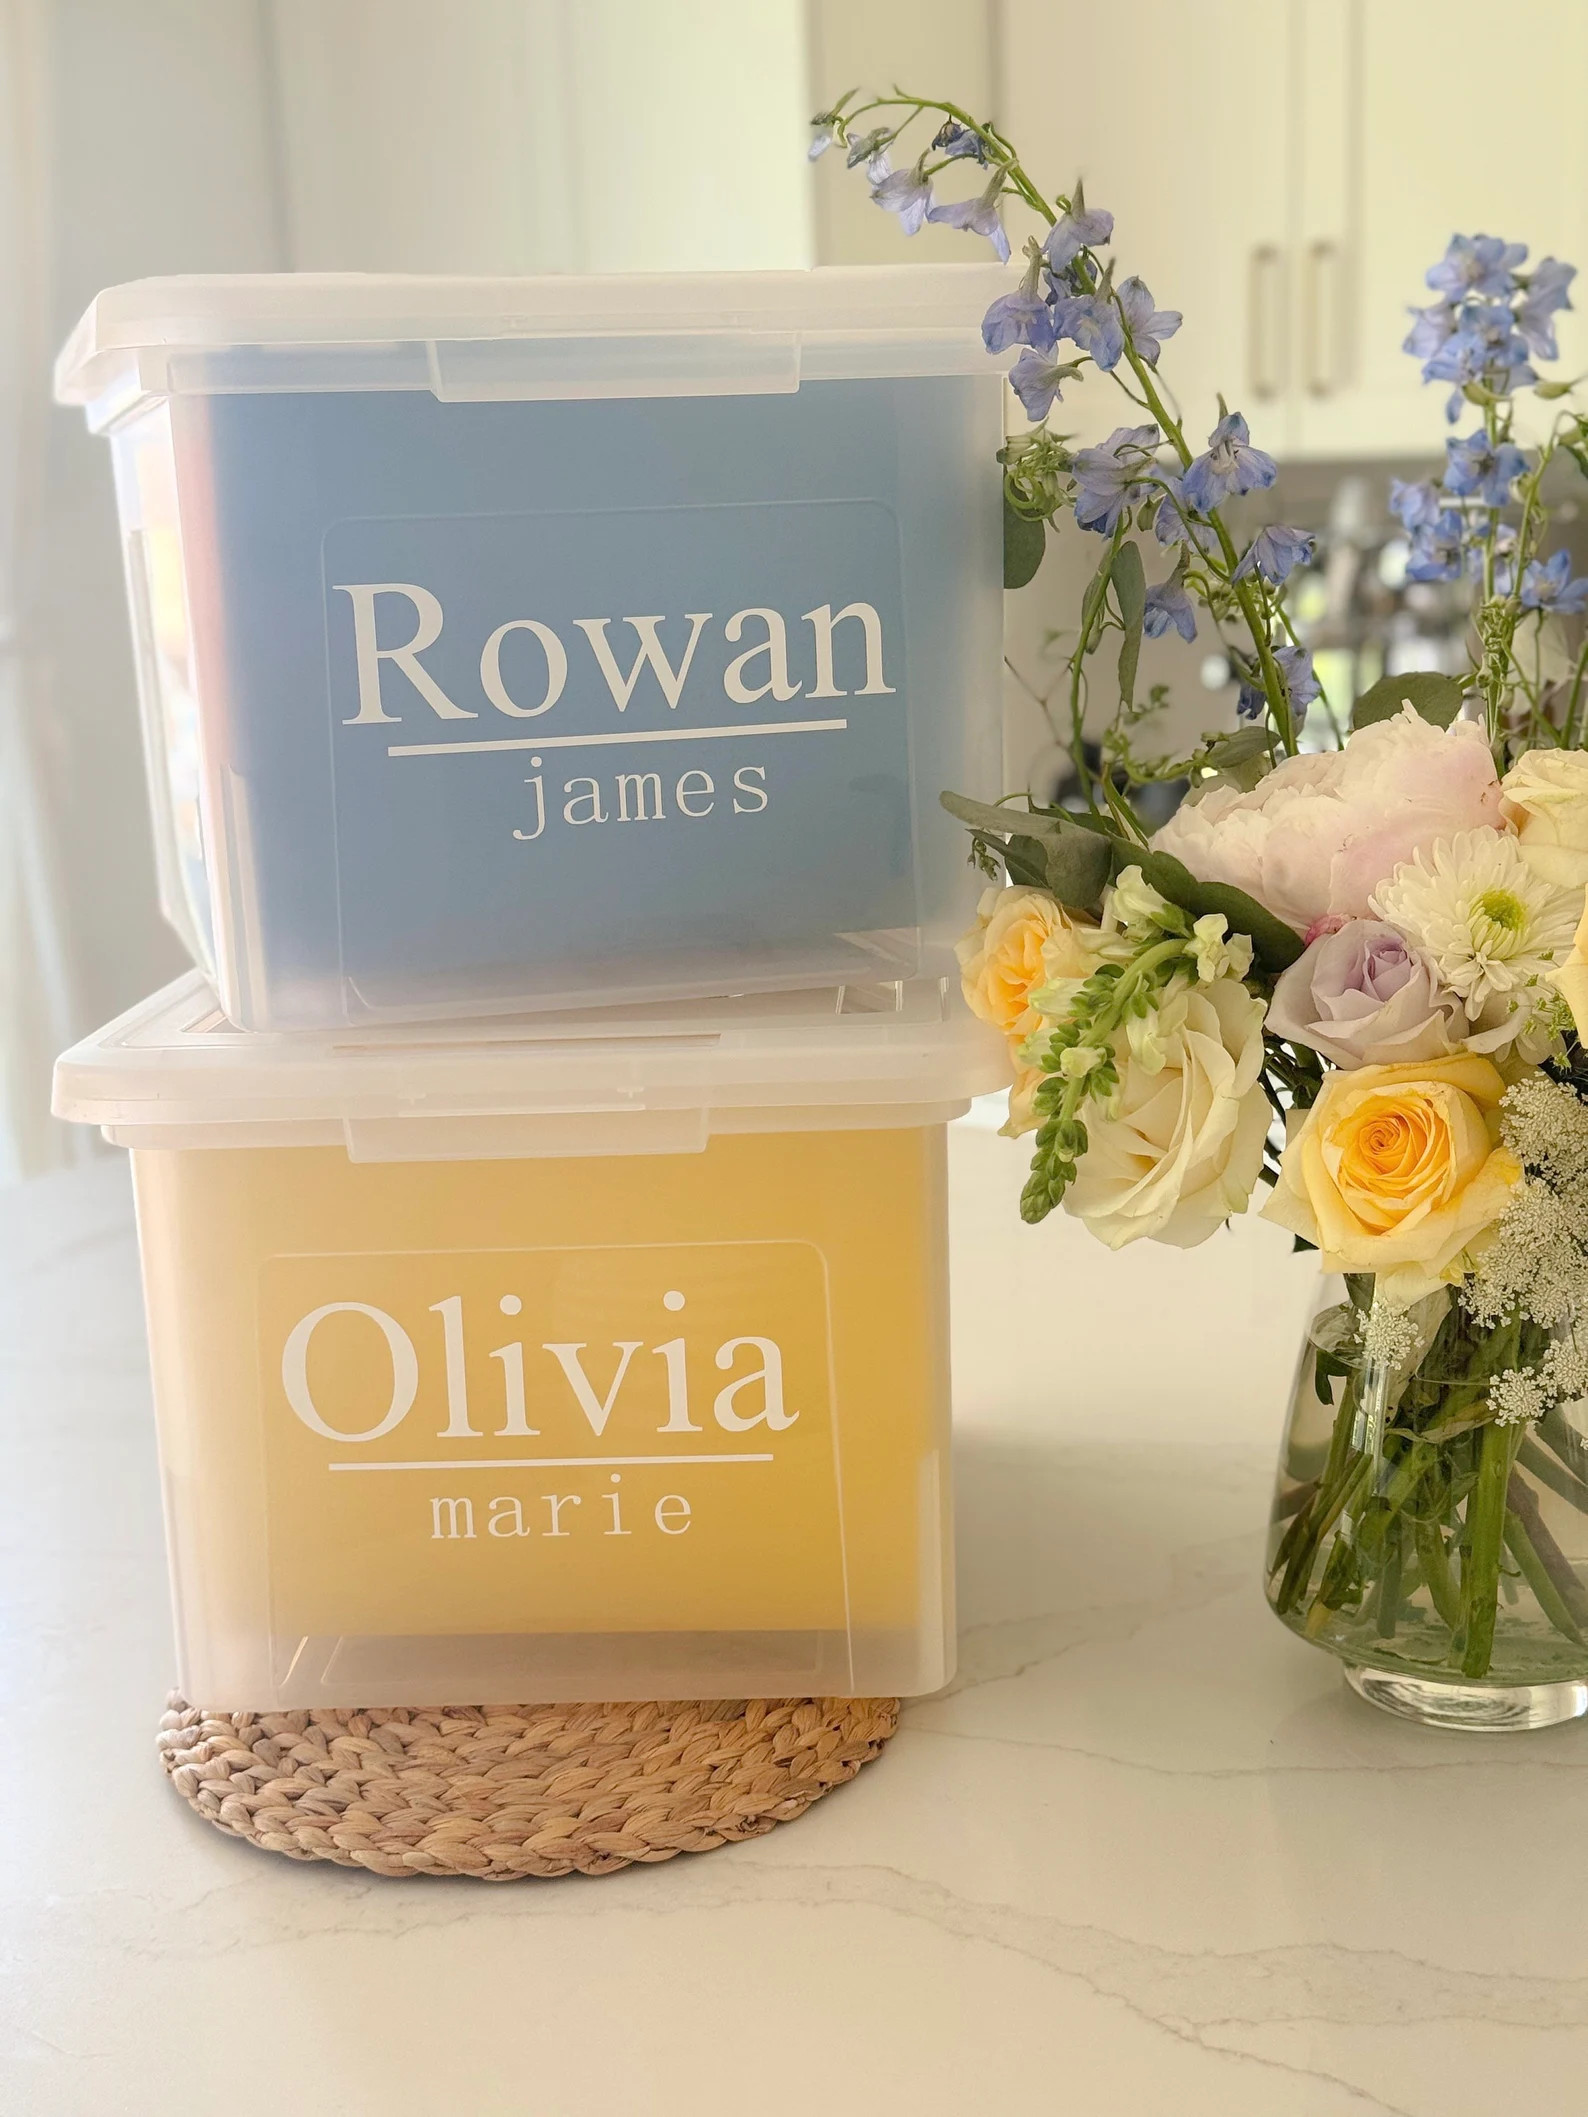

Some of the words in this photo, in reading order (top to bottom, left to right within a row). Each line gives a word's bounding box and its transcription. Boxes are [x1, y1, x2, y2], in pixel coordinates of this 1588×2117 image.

[332, 582, 897, 725] Rowan
[512, 756, 769, 841] james
[281, 1290, 800, 1442] Olivia
[430, 1473, 692, 1539] marie
